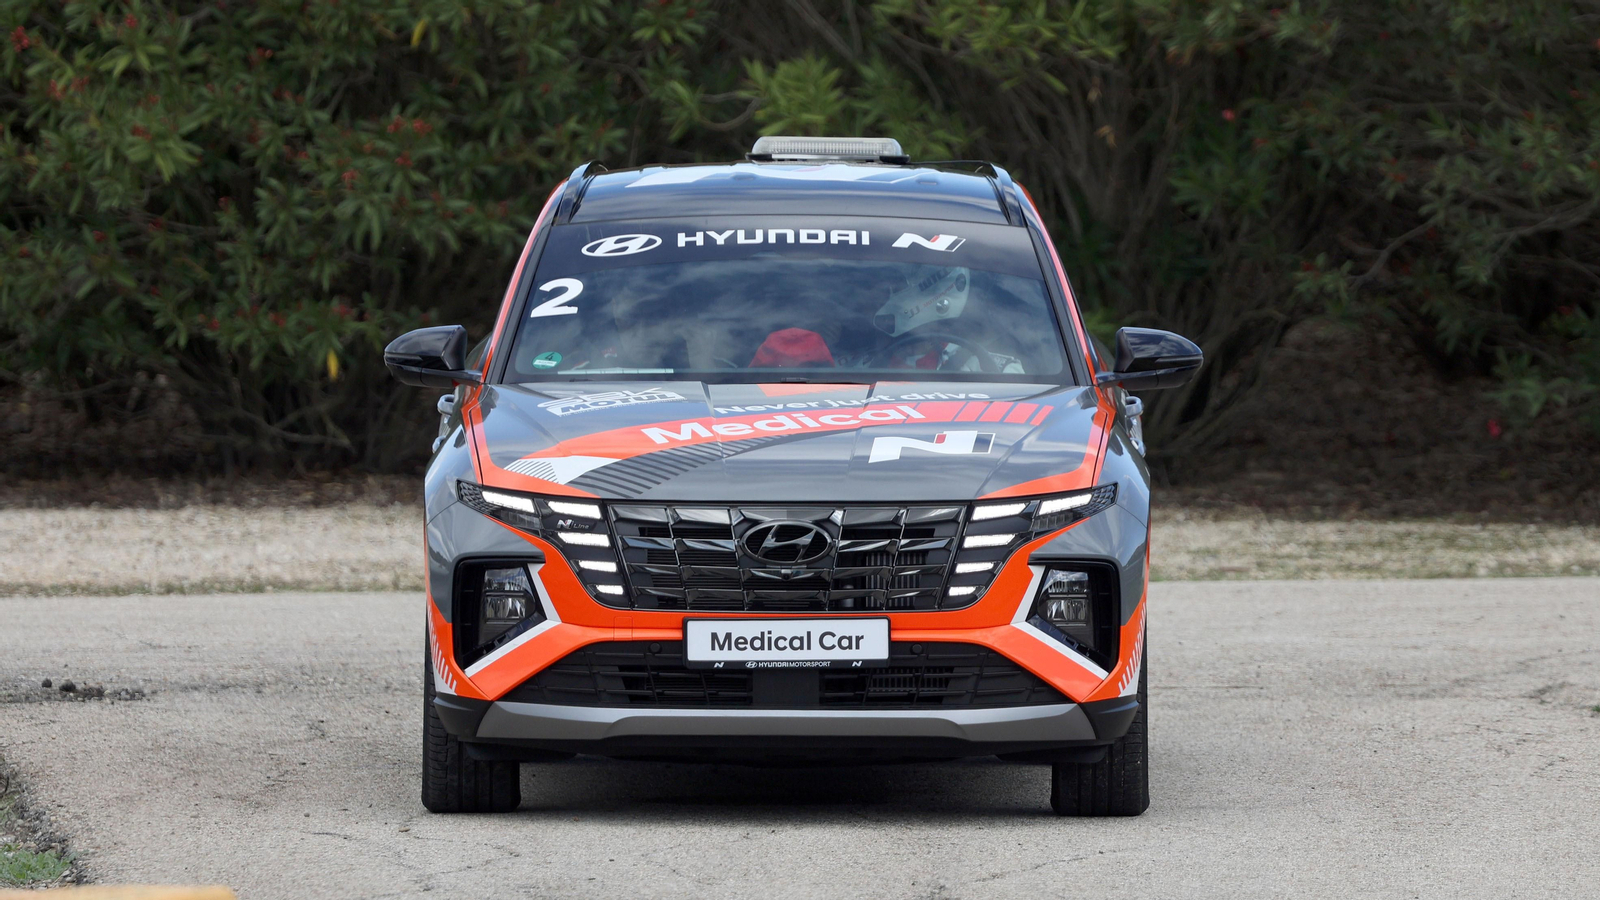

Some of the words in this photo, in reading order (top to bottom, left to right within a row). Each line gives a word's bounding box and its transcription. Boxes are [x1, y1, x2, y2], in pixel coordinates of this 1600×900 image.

[677, 228, 871, 248] HYUNDAI
[530, 277, 584, 318] 2
[560, 394, 676, 414] MOTUL
[714, 401, 820, 415] Never
[823, 394, 896, 408] just
[900, 391, 990, 401] drive
[641, 405, 926, 445] Medical
[710, 630, 812, 652] Medical
[818, 630, 865, 651] Car
[789, 660, 831, 668] MOTORSPORT
